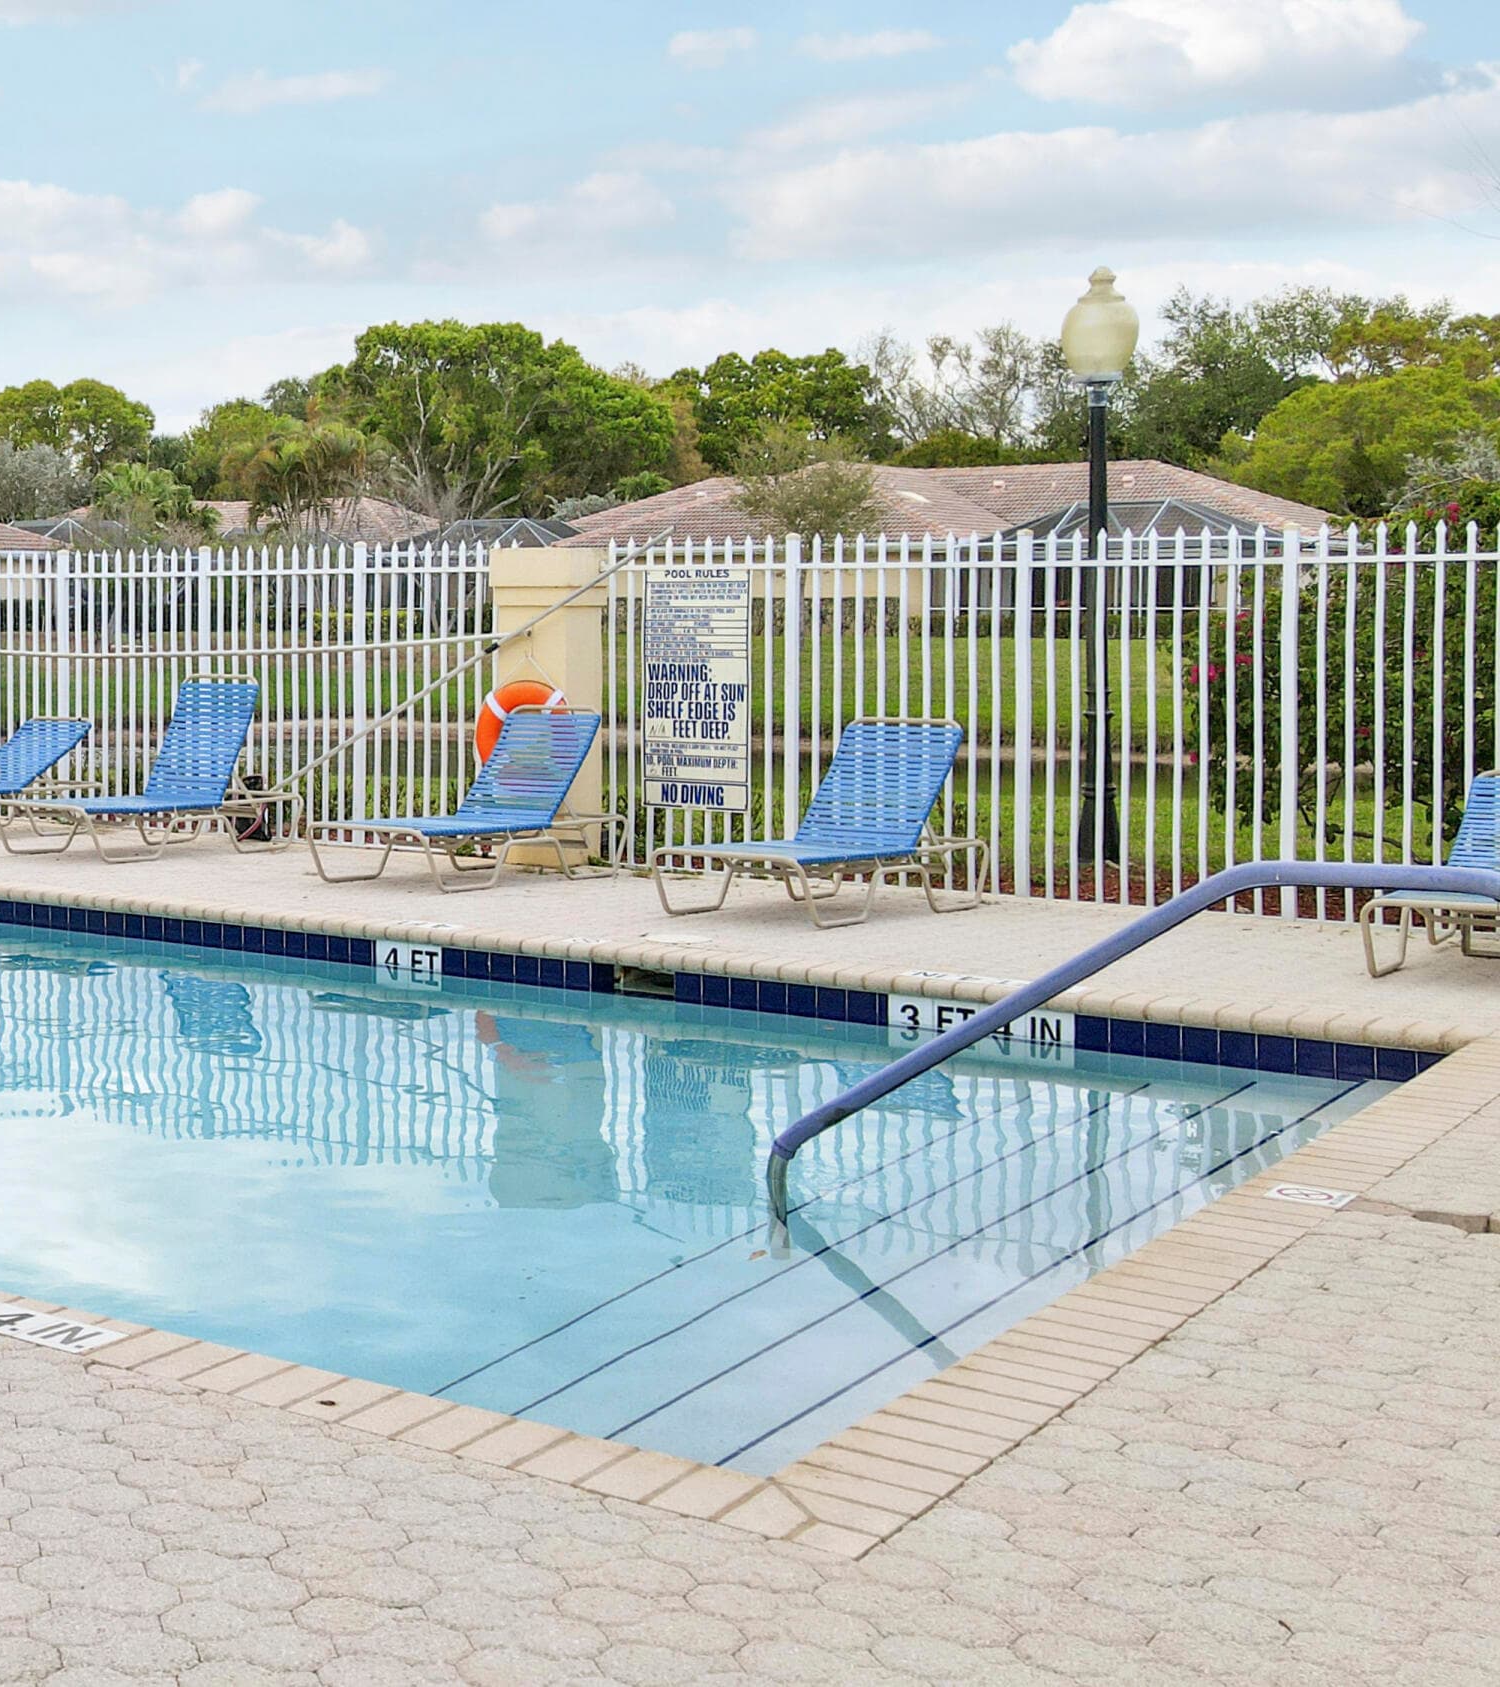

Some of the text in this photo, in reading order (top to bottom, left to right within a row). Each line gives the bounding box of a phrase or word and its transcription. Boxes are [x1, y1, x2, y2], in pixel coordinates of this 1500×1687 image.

[665, 569, 730, 578] POOL RULES
[648, 663, 712, 682] WARNING:
[648, 682, 745, 702] DROP OFF AT SUN
[647, 700, 736, 721] SHELF EDGE IS
[673, 720, 731, 740] FEET DEEP.
[657, 755, 675, 766] POOL
[677, 756, 712, 768] MAXIMUM
[661, 783, 724, 806] NO DIVING
[385, 948, 439, 971] 4 FT
[900, 1004, 920, 1030] 3
[1030, 1016, 1061, 1042] IN
